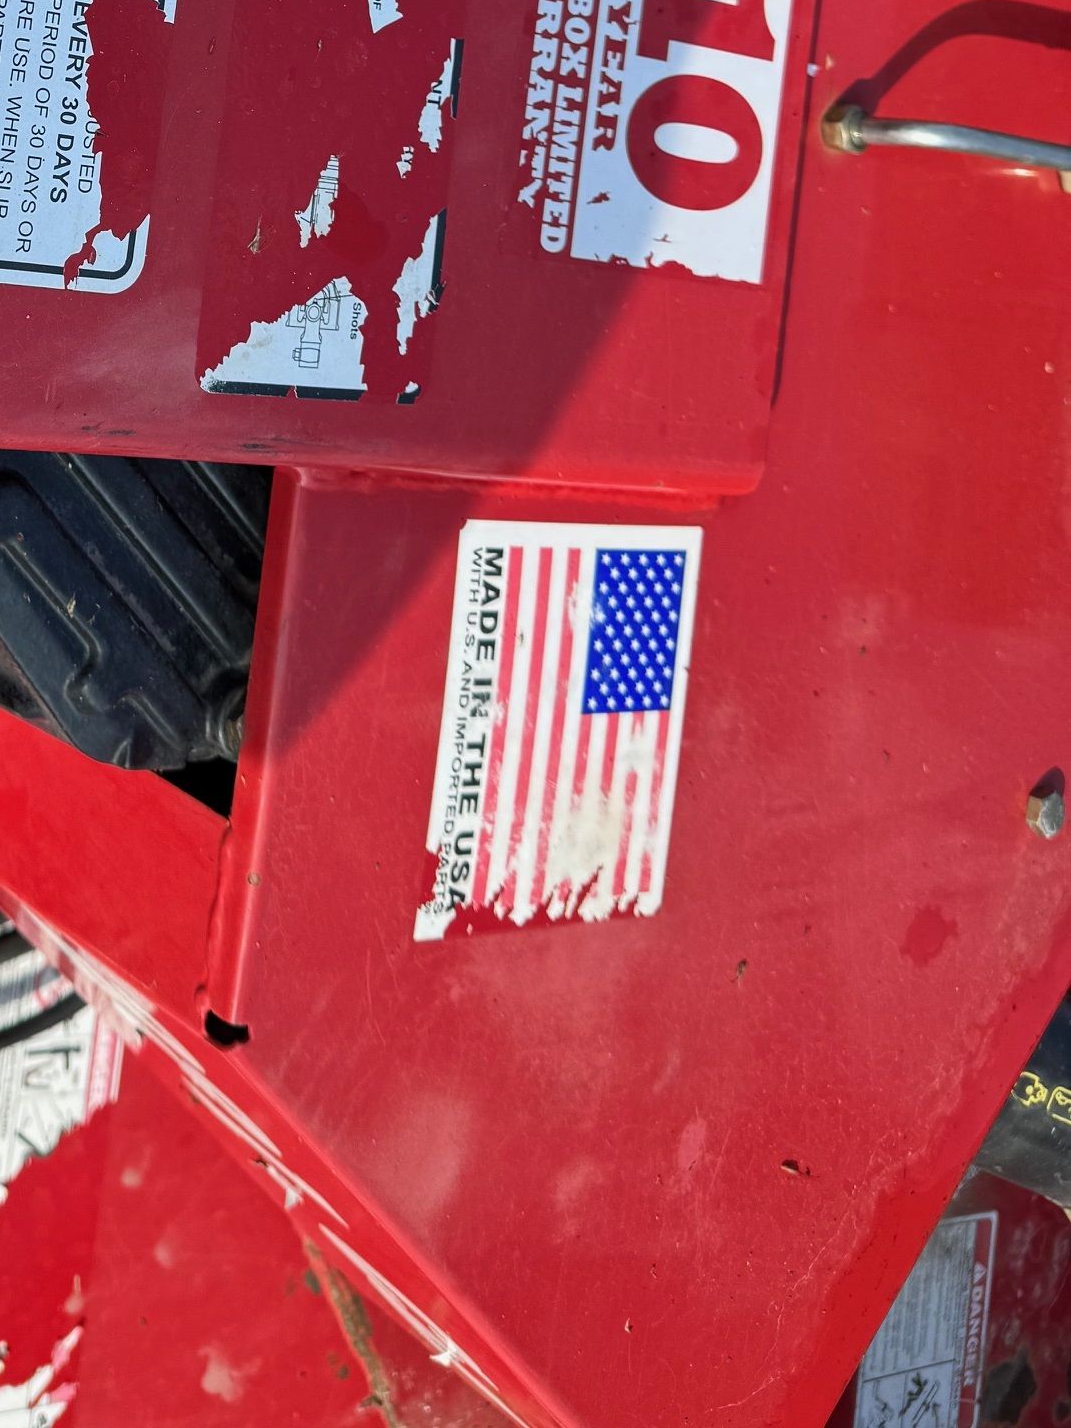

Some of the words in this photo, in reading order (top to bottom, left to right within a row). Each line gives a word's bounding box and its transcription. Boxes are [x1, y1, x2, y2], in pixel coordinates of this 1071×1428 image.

[9, 37, 31, 87] USE.
[64, 0, 92, 89] EVERY
[34, 87, 51, 118] OF
[592, 1, 633, 154] YEAR
[0, 96, 23, 163] WHEN
[29, 124, 46, 149] 30
[59, 96, 79, 125] 30
[20, 155, 43, 214] DAYS
[49, 133, 75, 203] DAYS
[538, 83, 585, 254] LIMITED
[15, 220, 34, 253] OR
[350, 302, 362, 340] Shots
[467, 546, 485, 604] WITH
[476, 548, 504, 661] MADE
[462, 611, 478, 654] U.S.
[457, 660, 474, 710] AND
[470, 678, 492, 718] IN
[441, 716, 468, 836] IMPORTED
[458, 733, 486, 815] THE
[445, 831, 474, 912] USA
[963, 1283, 985, 1388] DANGER
